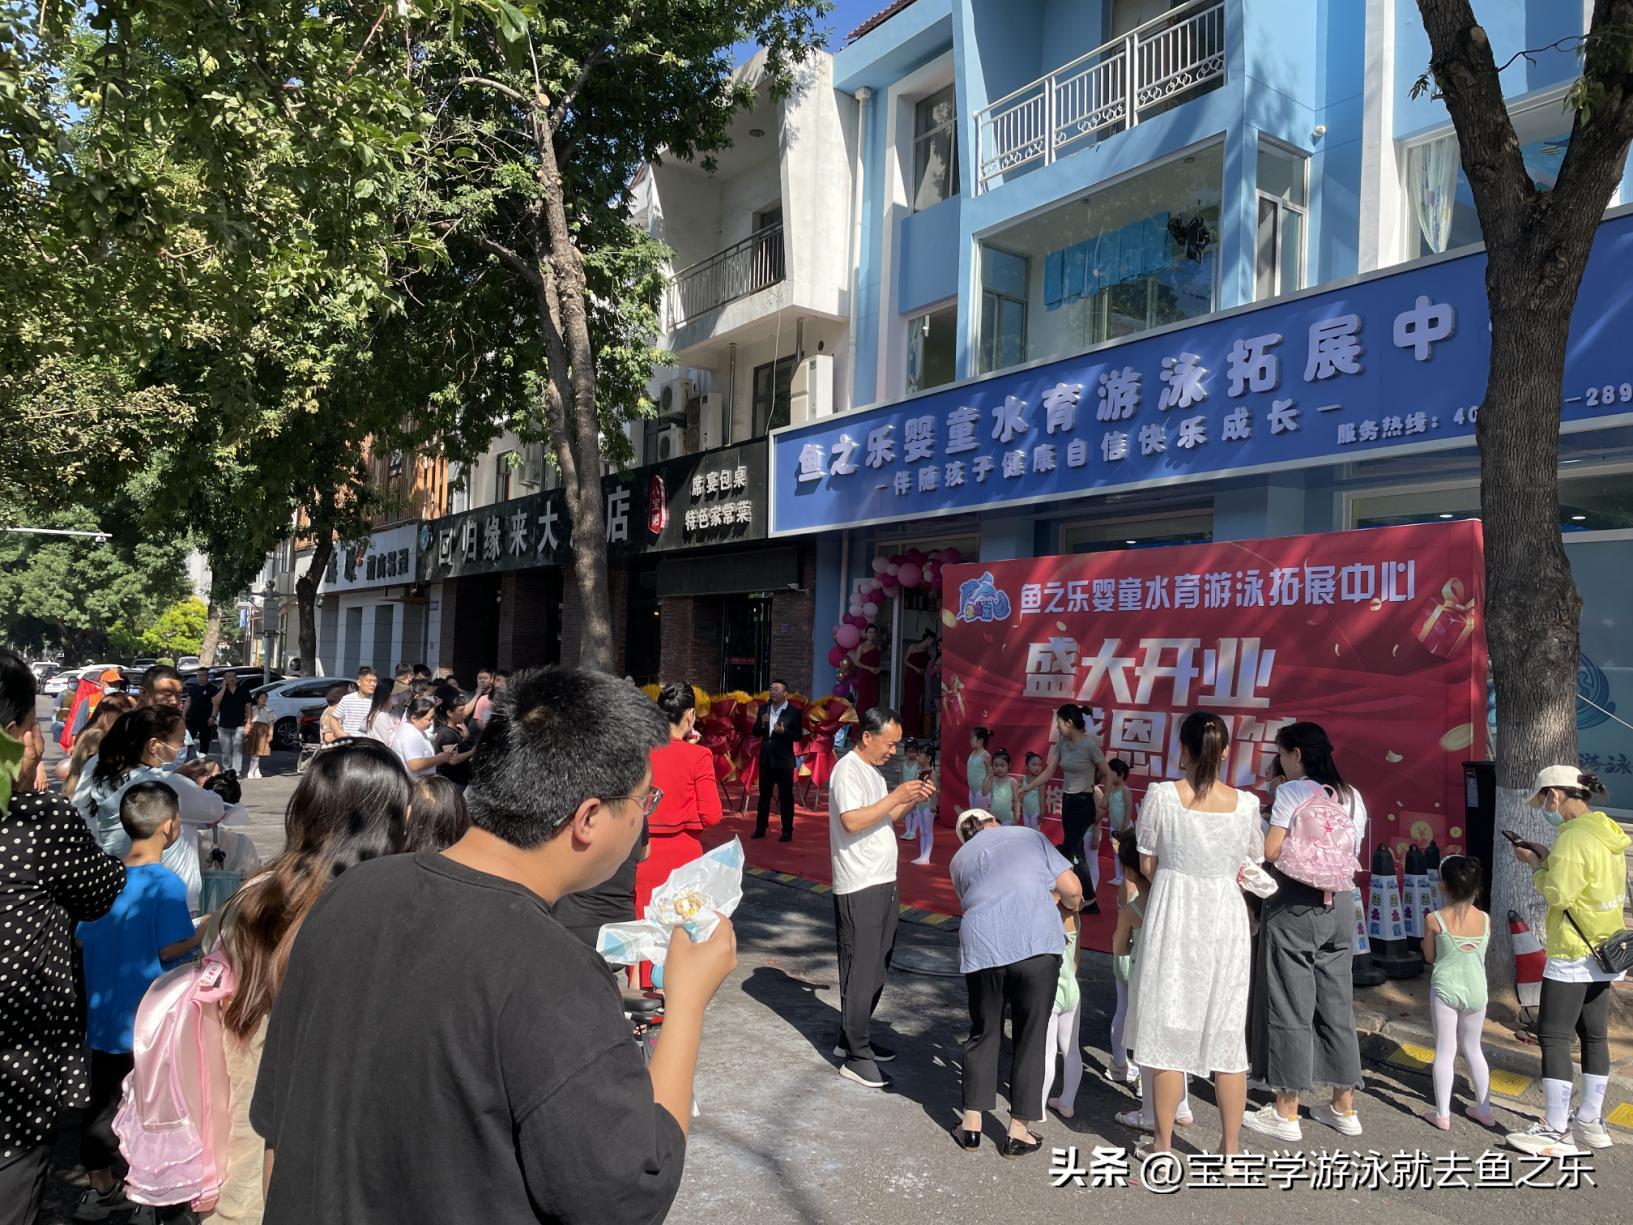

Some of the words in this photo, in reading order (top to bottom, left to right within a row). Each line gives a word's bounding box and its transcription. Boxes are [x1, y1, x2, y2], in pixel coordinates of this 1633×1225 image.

[798, 295, 1494, 483] 鱼之乐婴童水育游泳拓展中
[438, 485, 631, 567] 回归缘来大店
[1020, 560, 1415, 614] 鱼之乐婴童水育游泳拓展中心
[1022, 637, 1277, 708] 盛大开业
